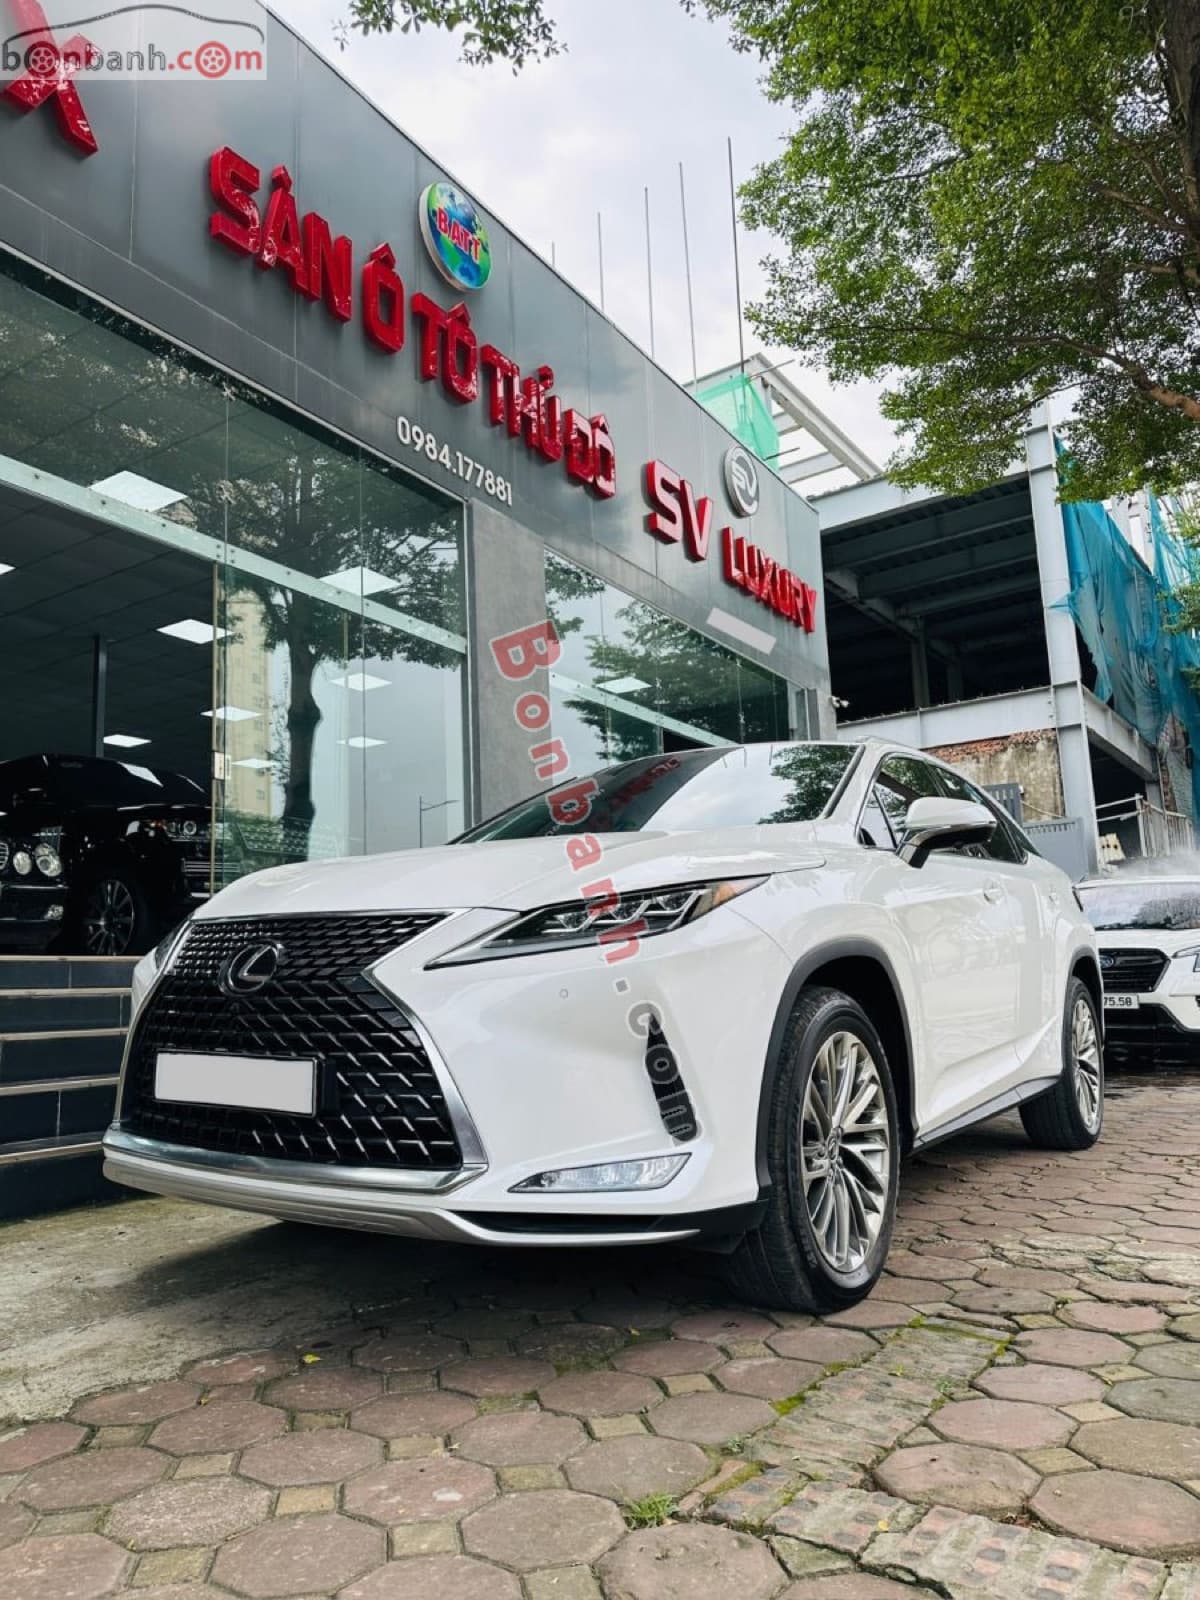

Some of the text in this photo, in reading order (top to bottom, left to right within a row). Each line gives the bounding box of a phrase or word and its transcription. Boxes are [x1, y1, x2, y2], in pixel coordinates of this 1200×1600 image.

[436, 206, 481, 264] BATT
[362, 242, 404, 353] Ô
[411, 292, 477, 403] TÔ
[480, 343, 562, 463] THỦ
[397, 416, 513, 506] 0984.177881
[646, 459, 817, 634] SV LUXURY
